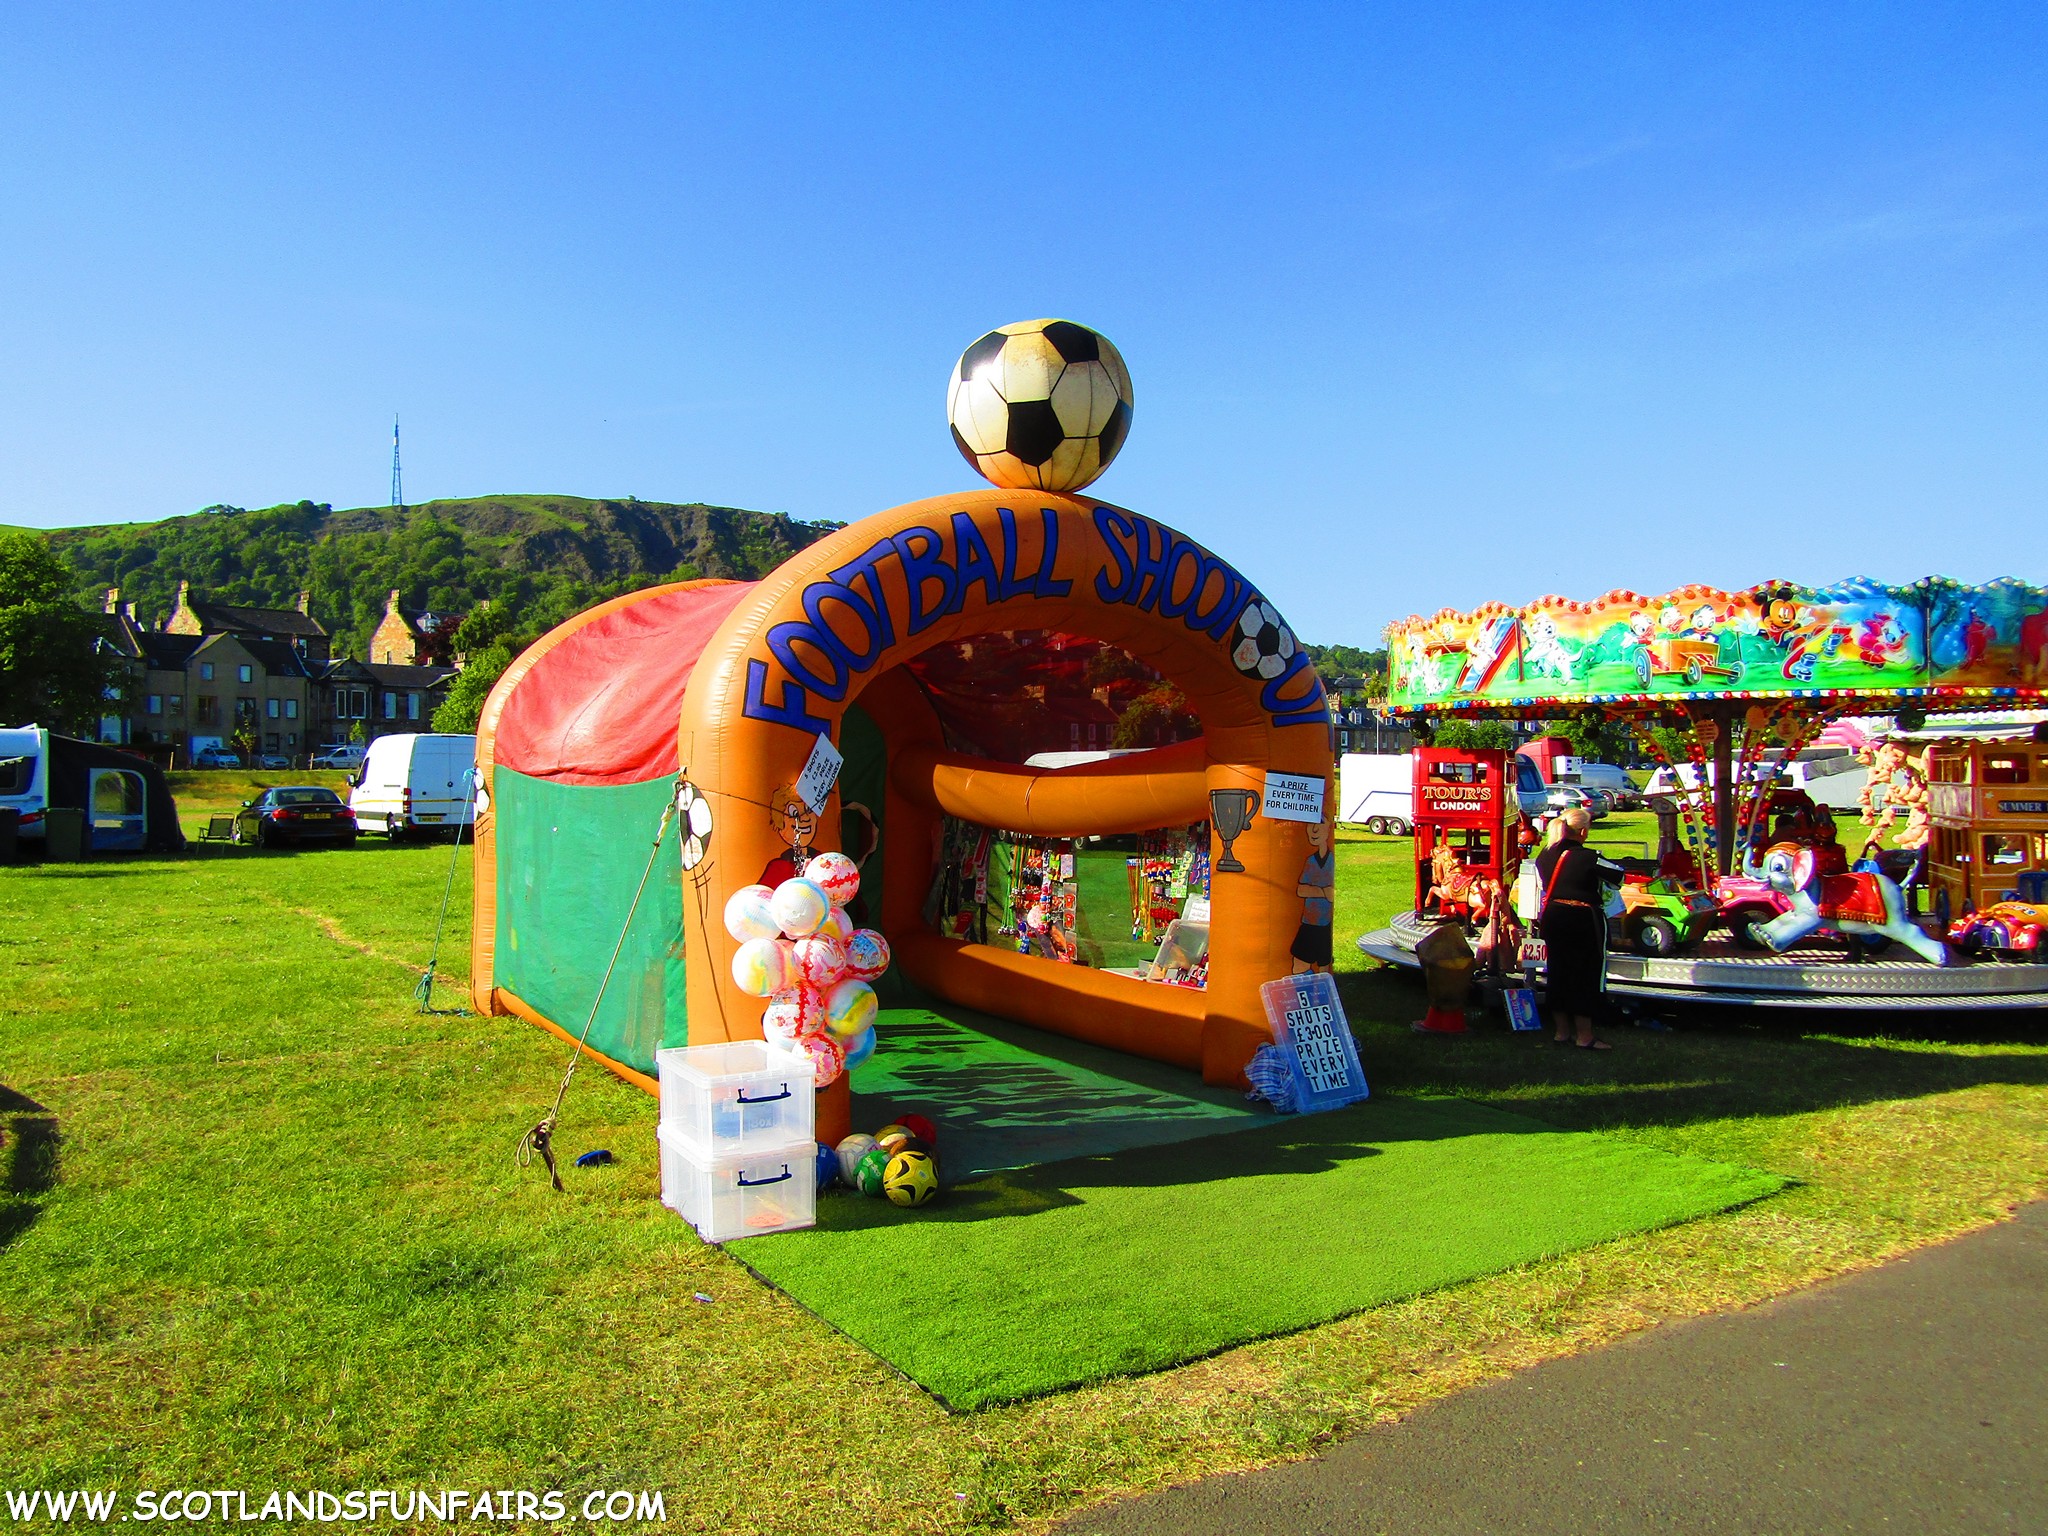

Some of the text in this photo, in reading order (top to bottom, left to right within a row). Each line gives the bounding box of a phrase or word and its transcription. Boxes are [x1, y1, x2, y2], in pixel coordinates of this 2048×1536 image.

[742, 507, 1074, 741] FOOTBALL
[1093, 506, 1264, 643] SHOOT
[807, 749, 819, 773] SHOTS
[820, 757, 830, 777] PRIZE
[815, 762, 834, 802] EVERY TIME
[826, 761, 840, 792] CHILDREN
[1280, 780, 1309, 790] A PRIZE
[1272, 790, 1315, 802] EVERY TIME
[1422, 786, 1492, 800] TOUR'S
[1266, 800, 1319, 812] FOR CHILDREN
[1433, 801, 1480, 811] LONDON
[1998, 802, 2041, 811] SUMMER
[1524, 944, 1547, 961] £2.50
[1299, 992, 1308, 1007] 5
[1286, 1006, 1331, 1027] SHOTS
[1296, 1038, 1342, 1059] PRIZE
[1301, 1054, 1347, 1076] EVERY
[1311, 1071, 1348, 1091] TIME
